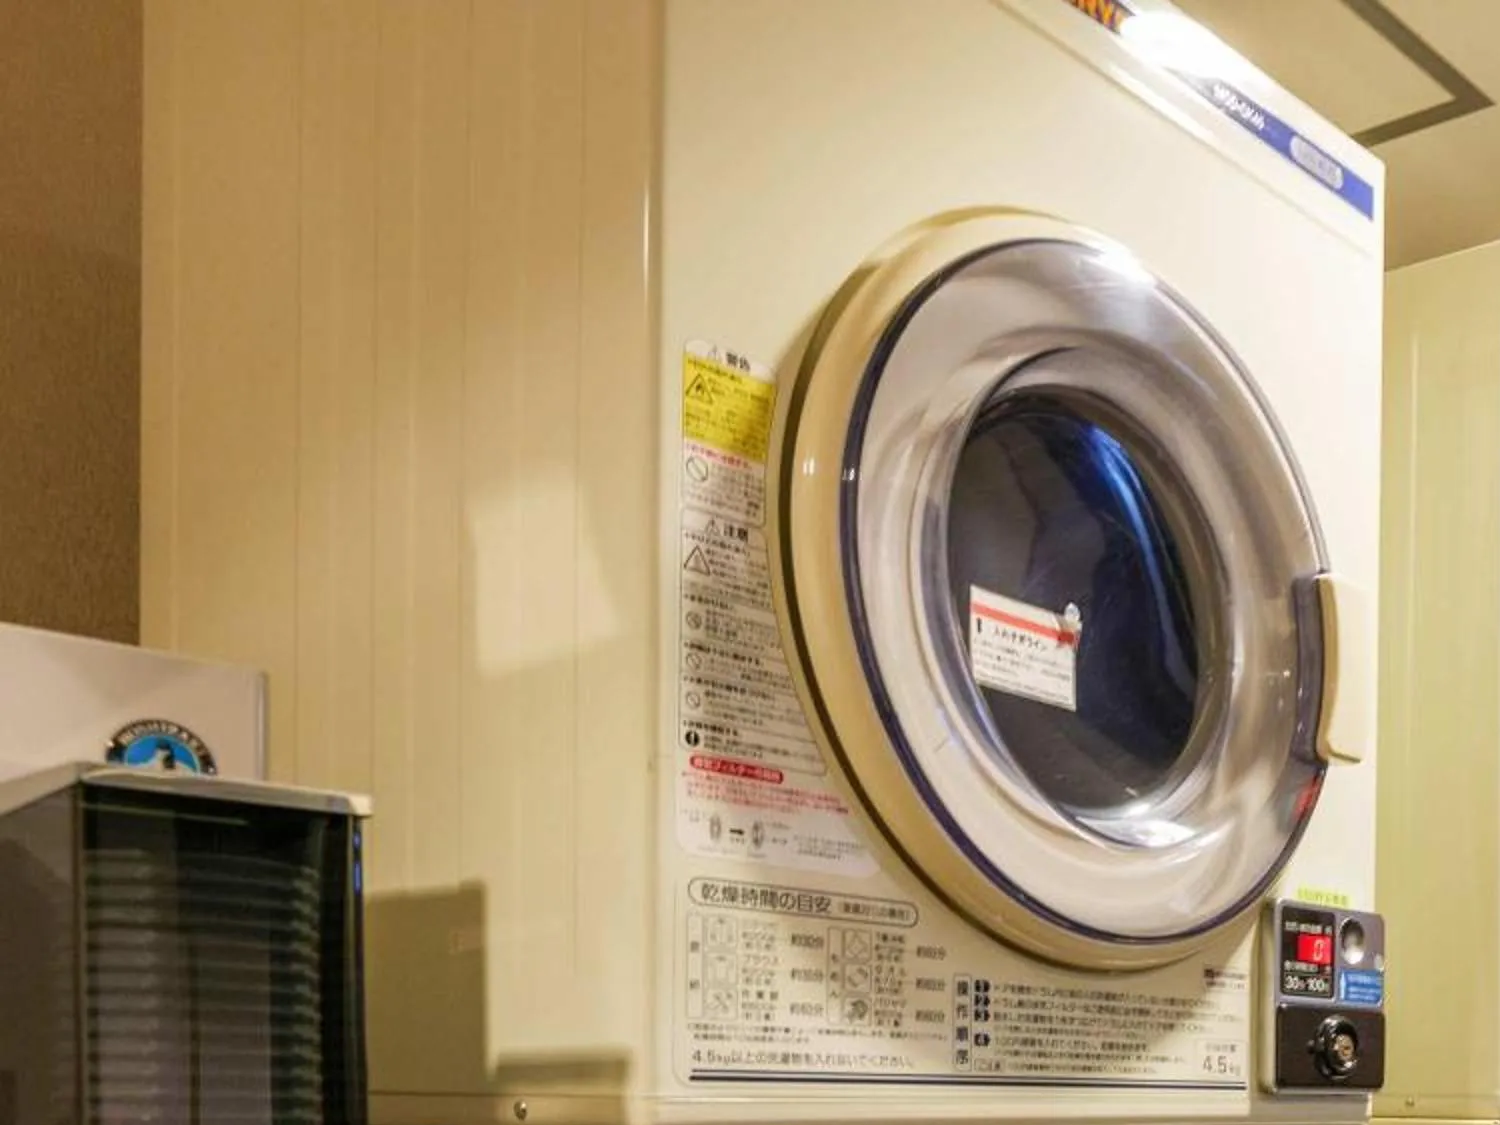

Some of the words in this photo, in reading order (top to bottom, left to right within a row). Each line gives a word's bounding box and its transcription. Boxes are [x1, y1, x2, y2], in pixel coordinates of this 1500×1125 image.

[701, 883, 833, 914] 乾燥時間の目安
